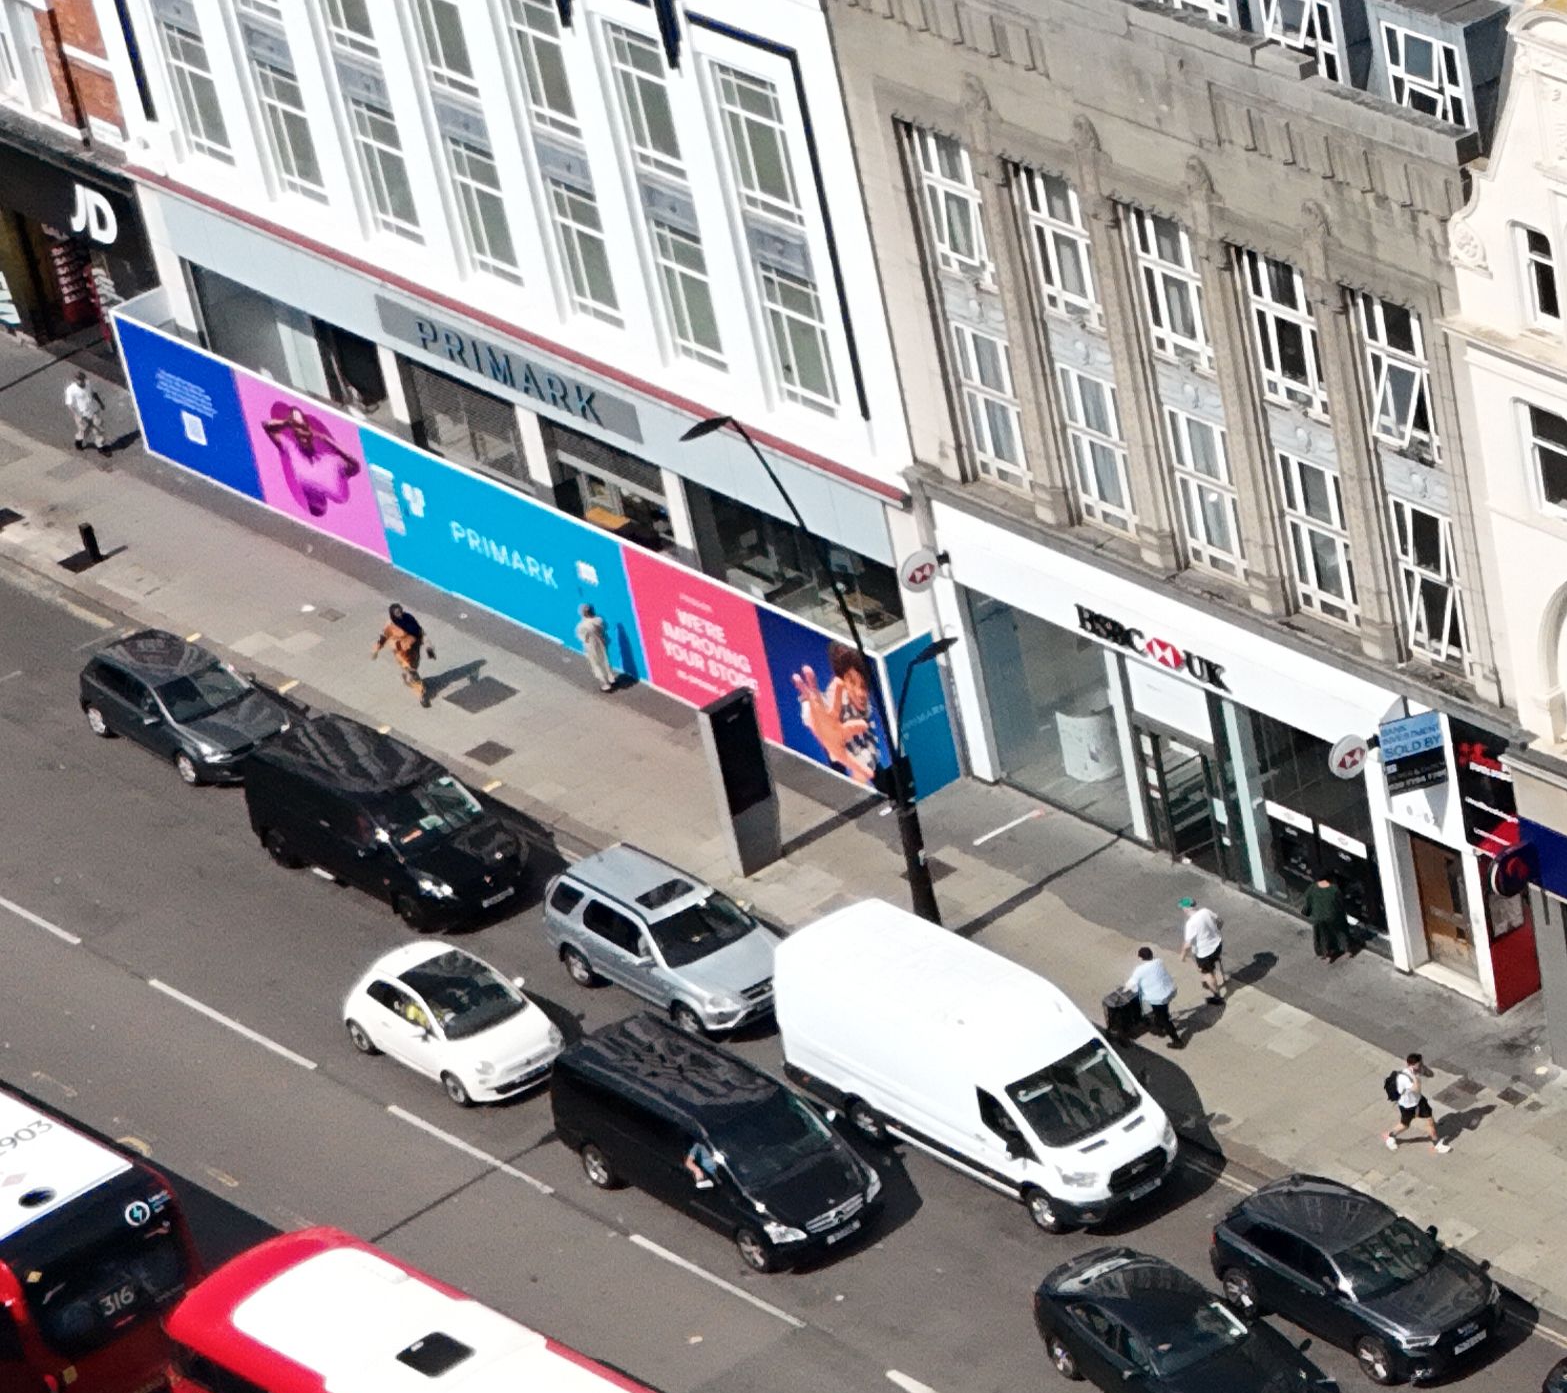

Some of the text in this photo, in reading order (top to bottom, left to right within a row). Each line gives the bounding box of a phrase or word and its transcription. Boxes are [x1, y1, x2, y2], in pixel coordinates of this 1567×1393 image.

[70, 183, 118, 244] JD
[416, 318, 606, 429] PRIMARK
[450, 520, 559, 589] PRIMARK
[662, 619, 752, 674] IMPROVING
[662, 638, 706, 673] YOUR
[1074, 603, 1233, 695] HSBC UK
[1384, 735, 1441, 758] SOLD BY
[0, 1118, 54, 1156] 903
[100, 1285, 135, 1316] 316
